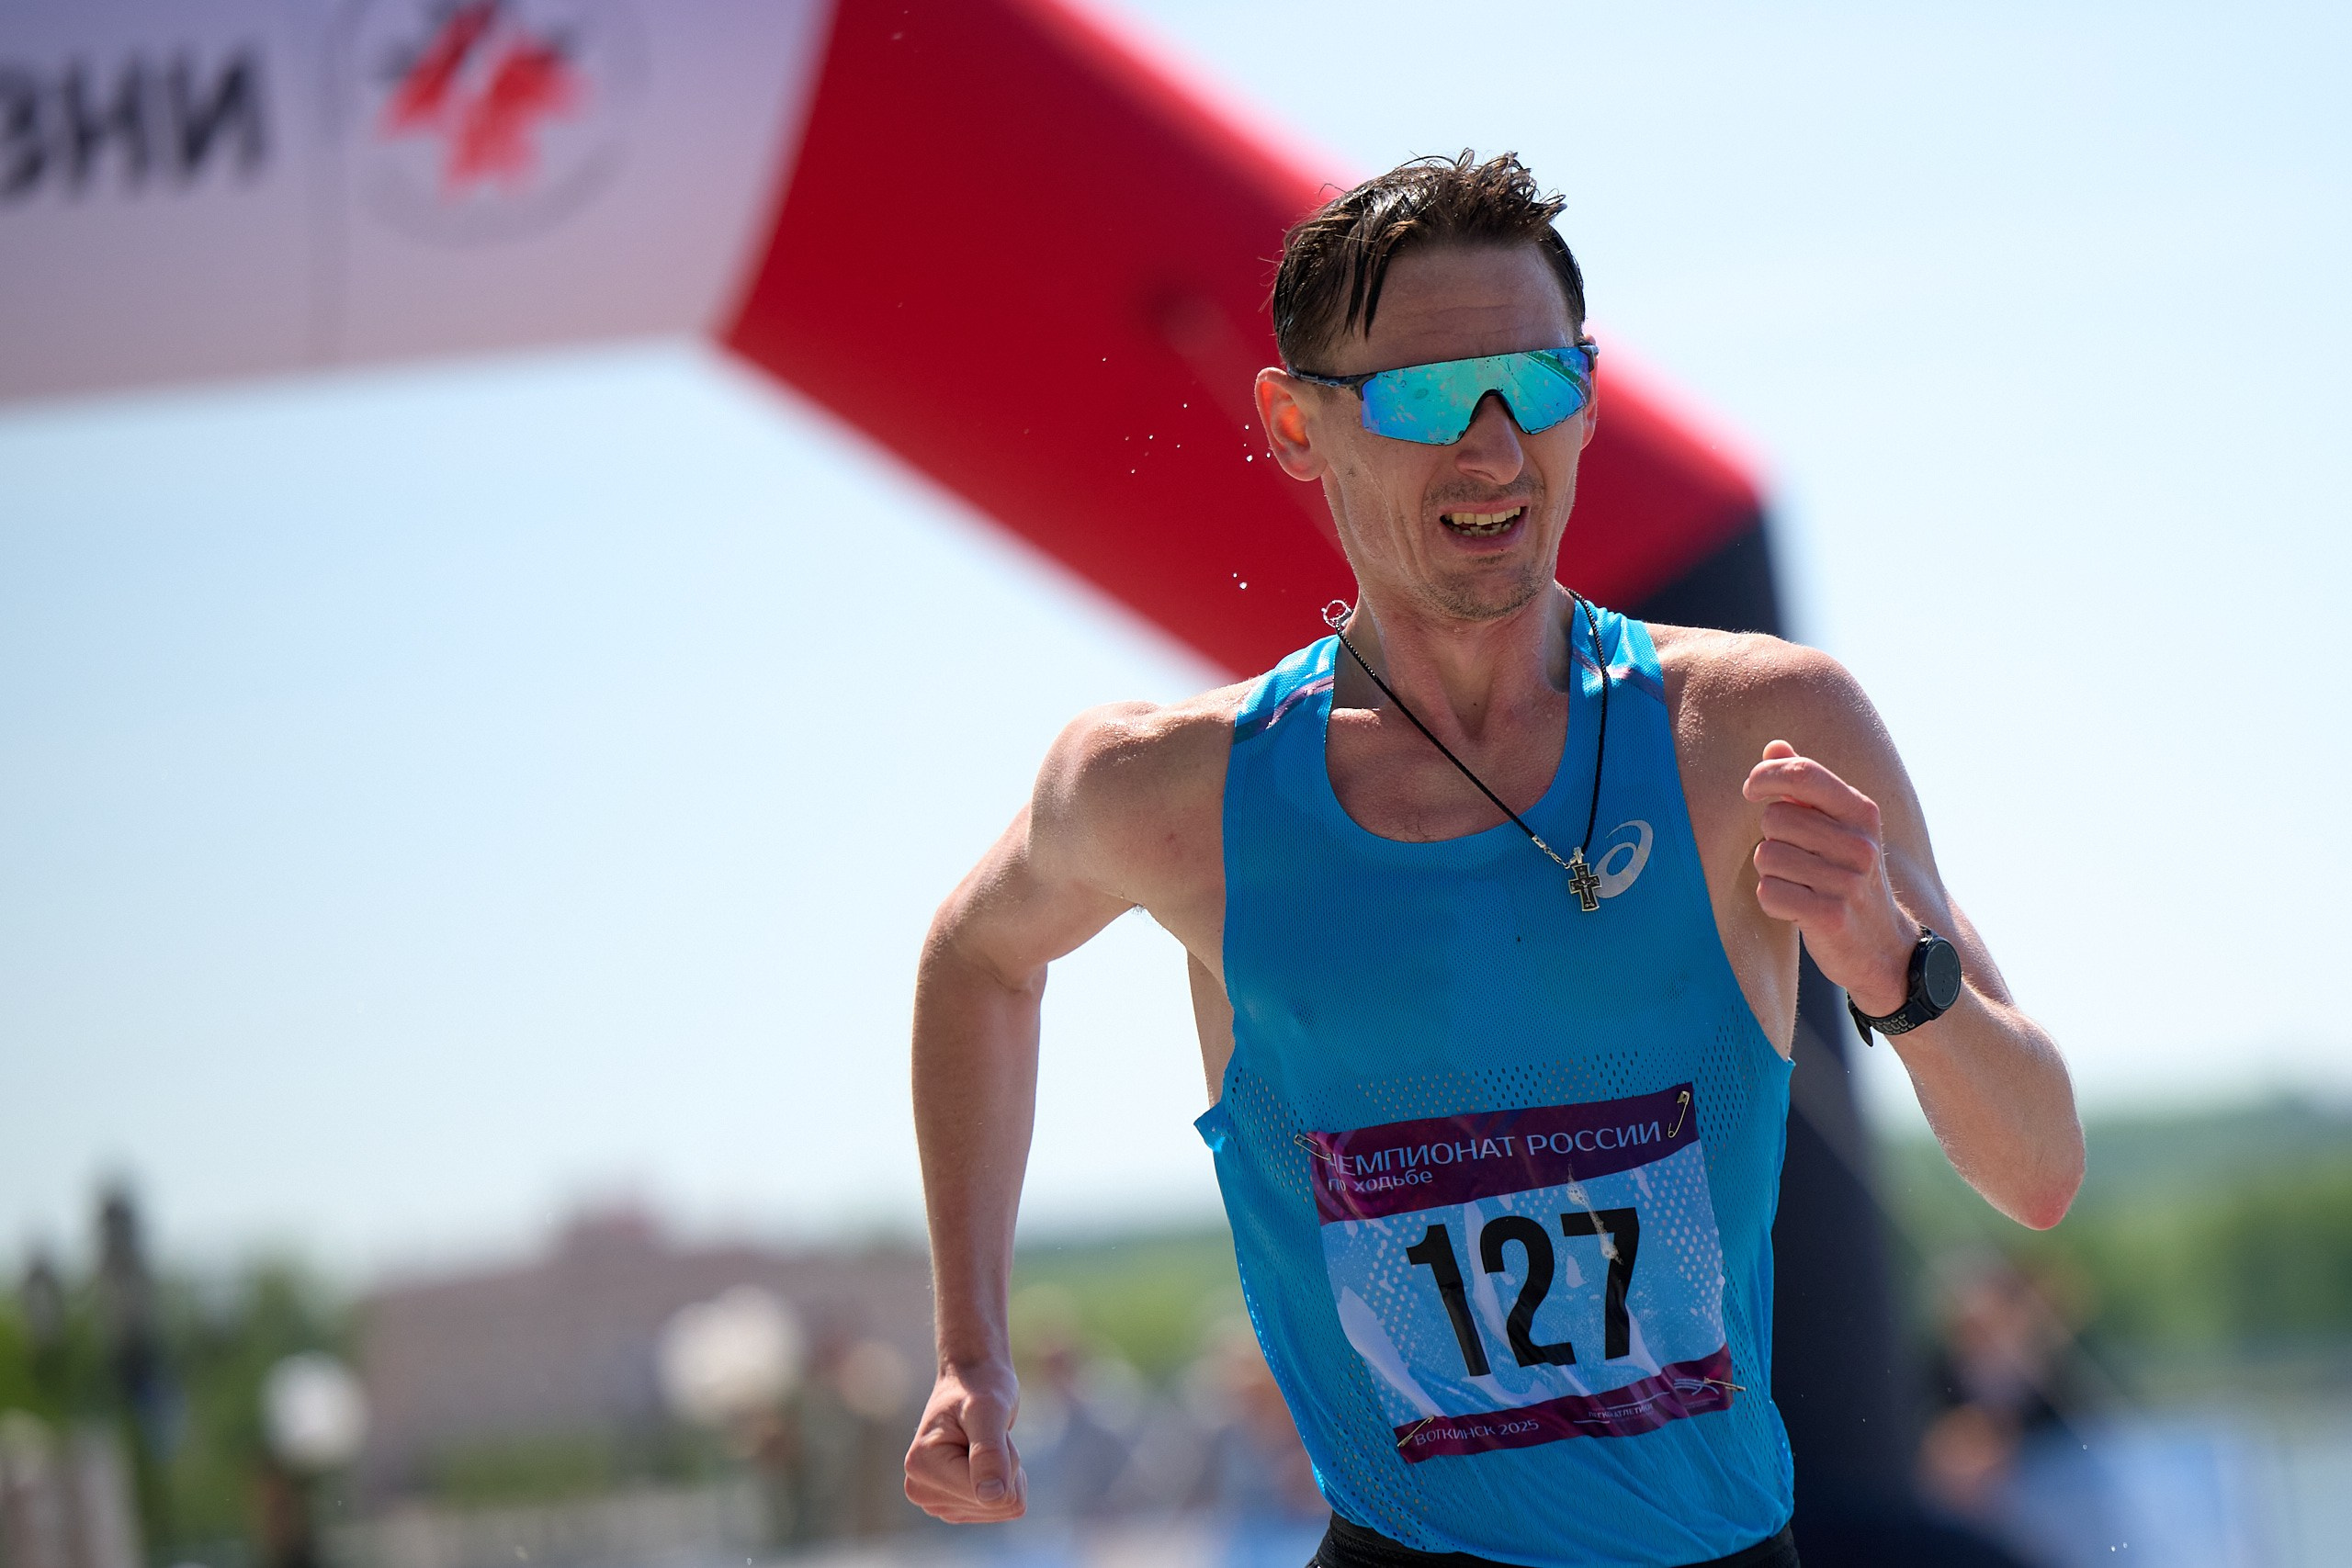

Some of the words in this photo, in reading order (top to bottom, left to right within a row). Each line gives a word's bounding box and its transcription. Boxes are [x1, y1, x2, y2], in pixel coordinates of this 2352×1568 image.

[1526, 1121, 1661, 1156] РОССИИ
[1353, 1168, 1433, 1193] ходьбе
[1406, 1207, 1640, 1378] 127
[1415, 1425, 1495, 1446] ВОТКИНСК
[1497, 1418, 1540, 1436] 2025
